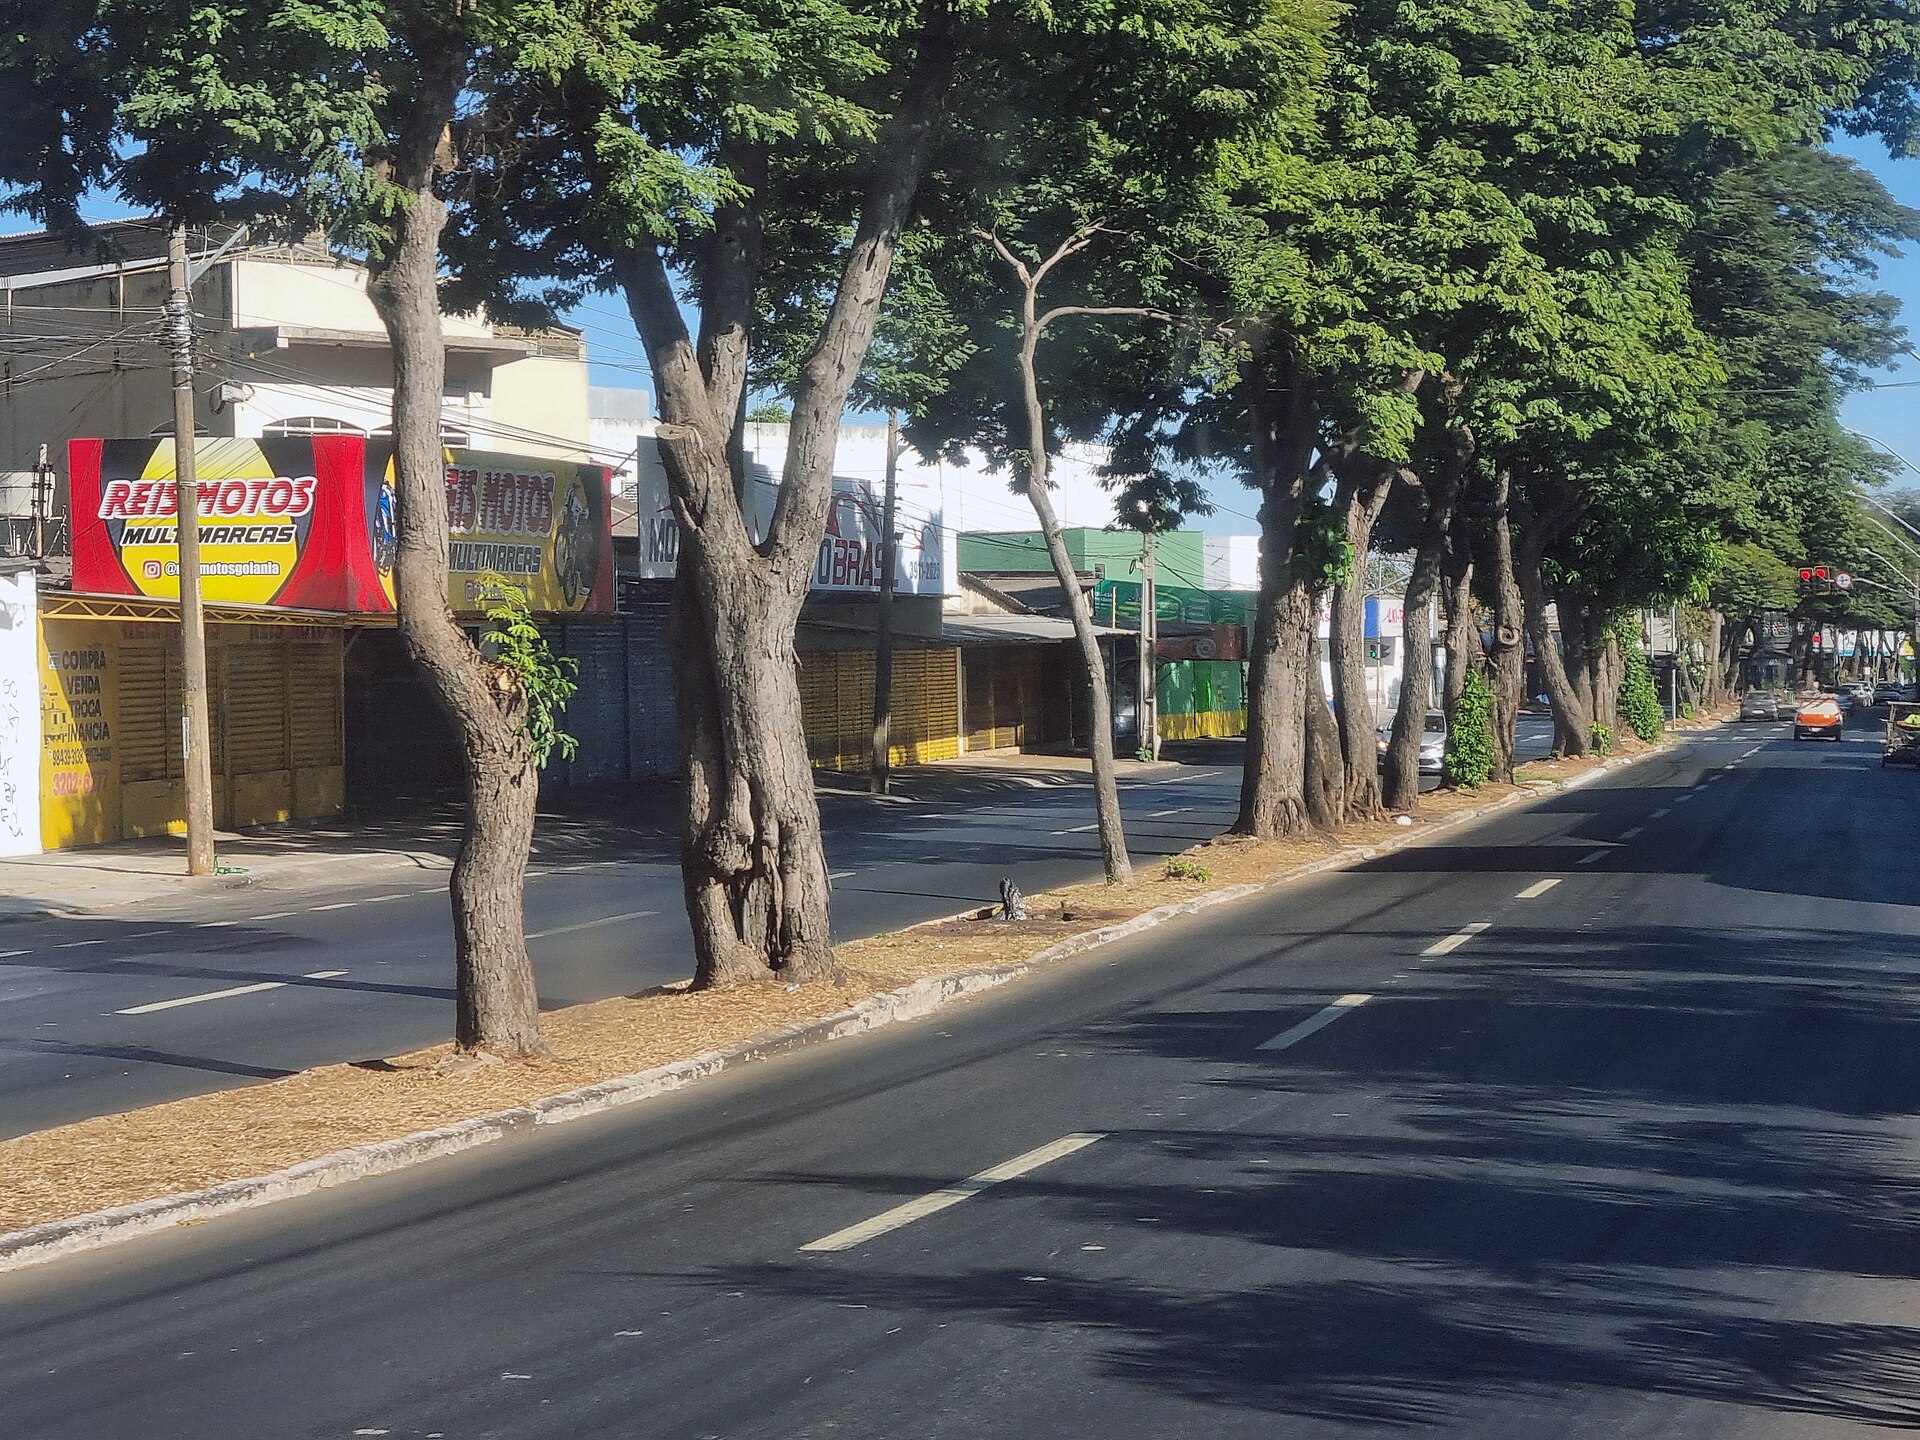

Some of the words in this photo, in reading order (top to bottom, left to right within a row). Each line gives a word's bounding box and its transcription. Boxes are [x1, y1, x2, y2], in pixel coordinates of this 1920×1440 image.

[101, 479, 178, 516] REIS
[196, 479, 314, 516] MOTOS
[445, 467, 478, 531] EIS
[480, 471, 555, 534] MOTOS
[122, 526, 296, 546] MULTMARCAS
[62, 650, 107, 670] COMPRA
[66, 675, 101, 694] VENDA
[70, 698, 102, 718] TROCA
